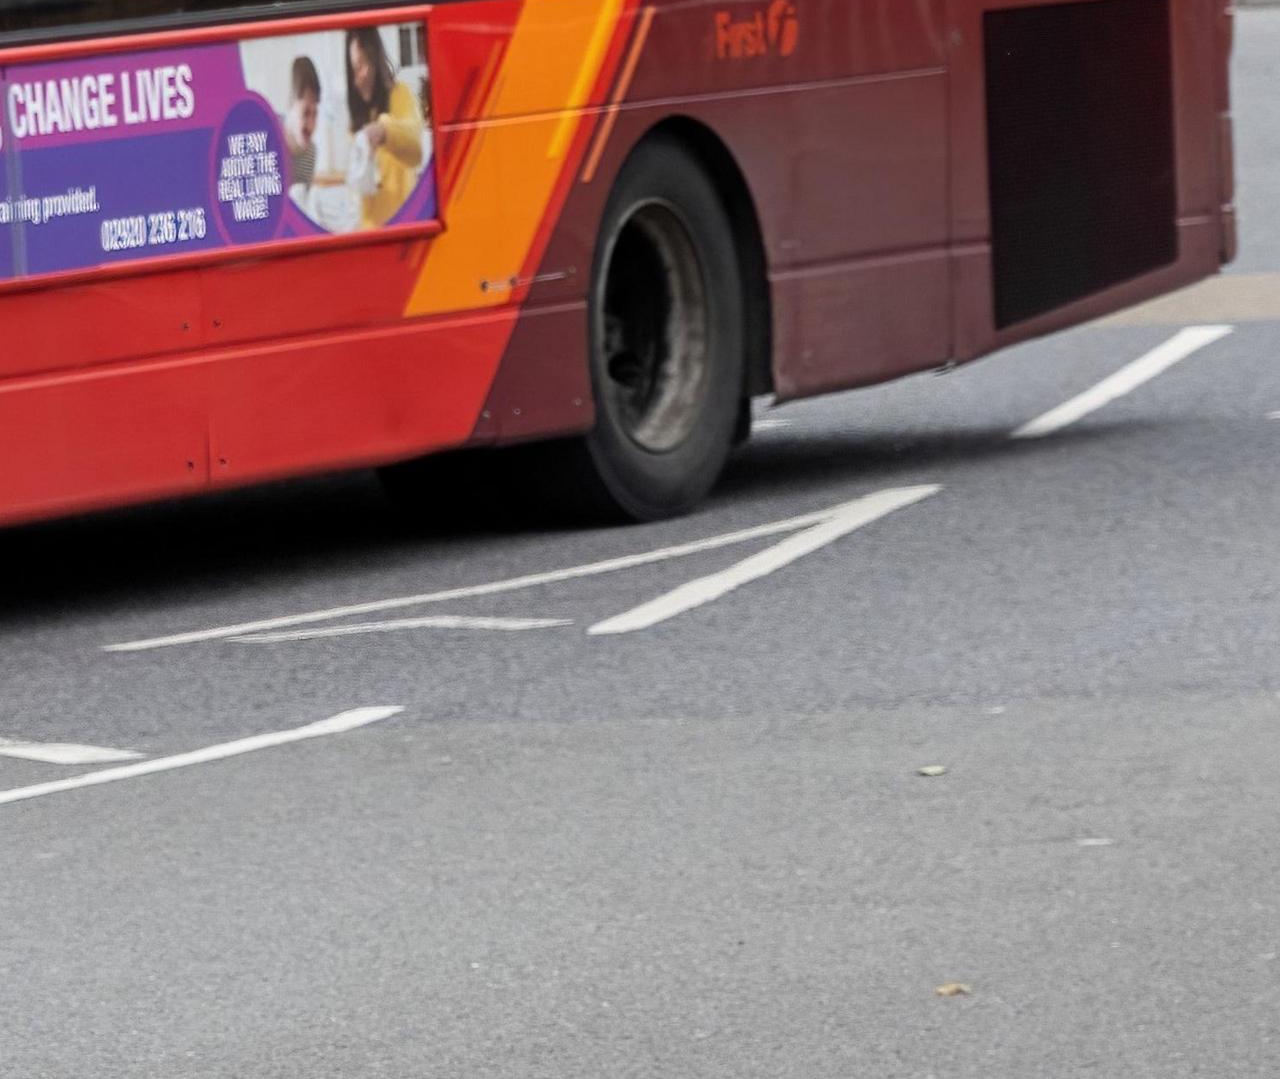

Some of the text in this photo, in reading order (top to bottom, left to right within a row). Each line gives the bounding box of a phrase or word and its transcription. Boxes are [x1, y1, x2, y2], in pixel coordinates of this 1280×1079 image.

[8, 73, 118, 139] CHANGE
[121, 64, 195, 124] LIVES
[42, 185, 100, 223] provided.
